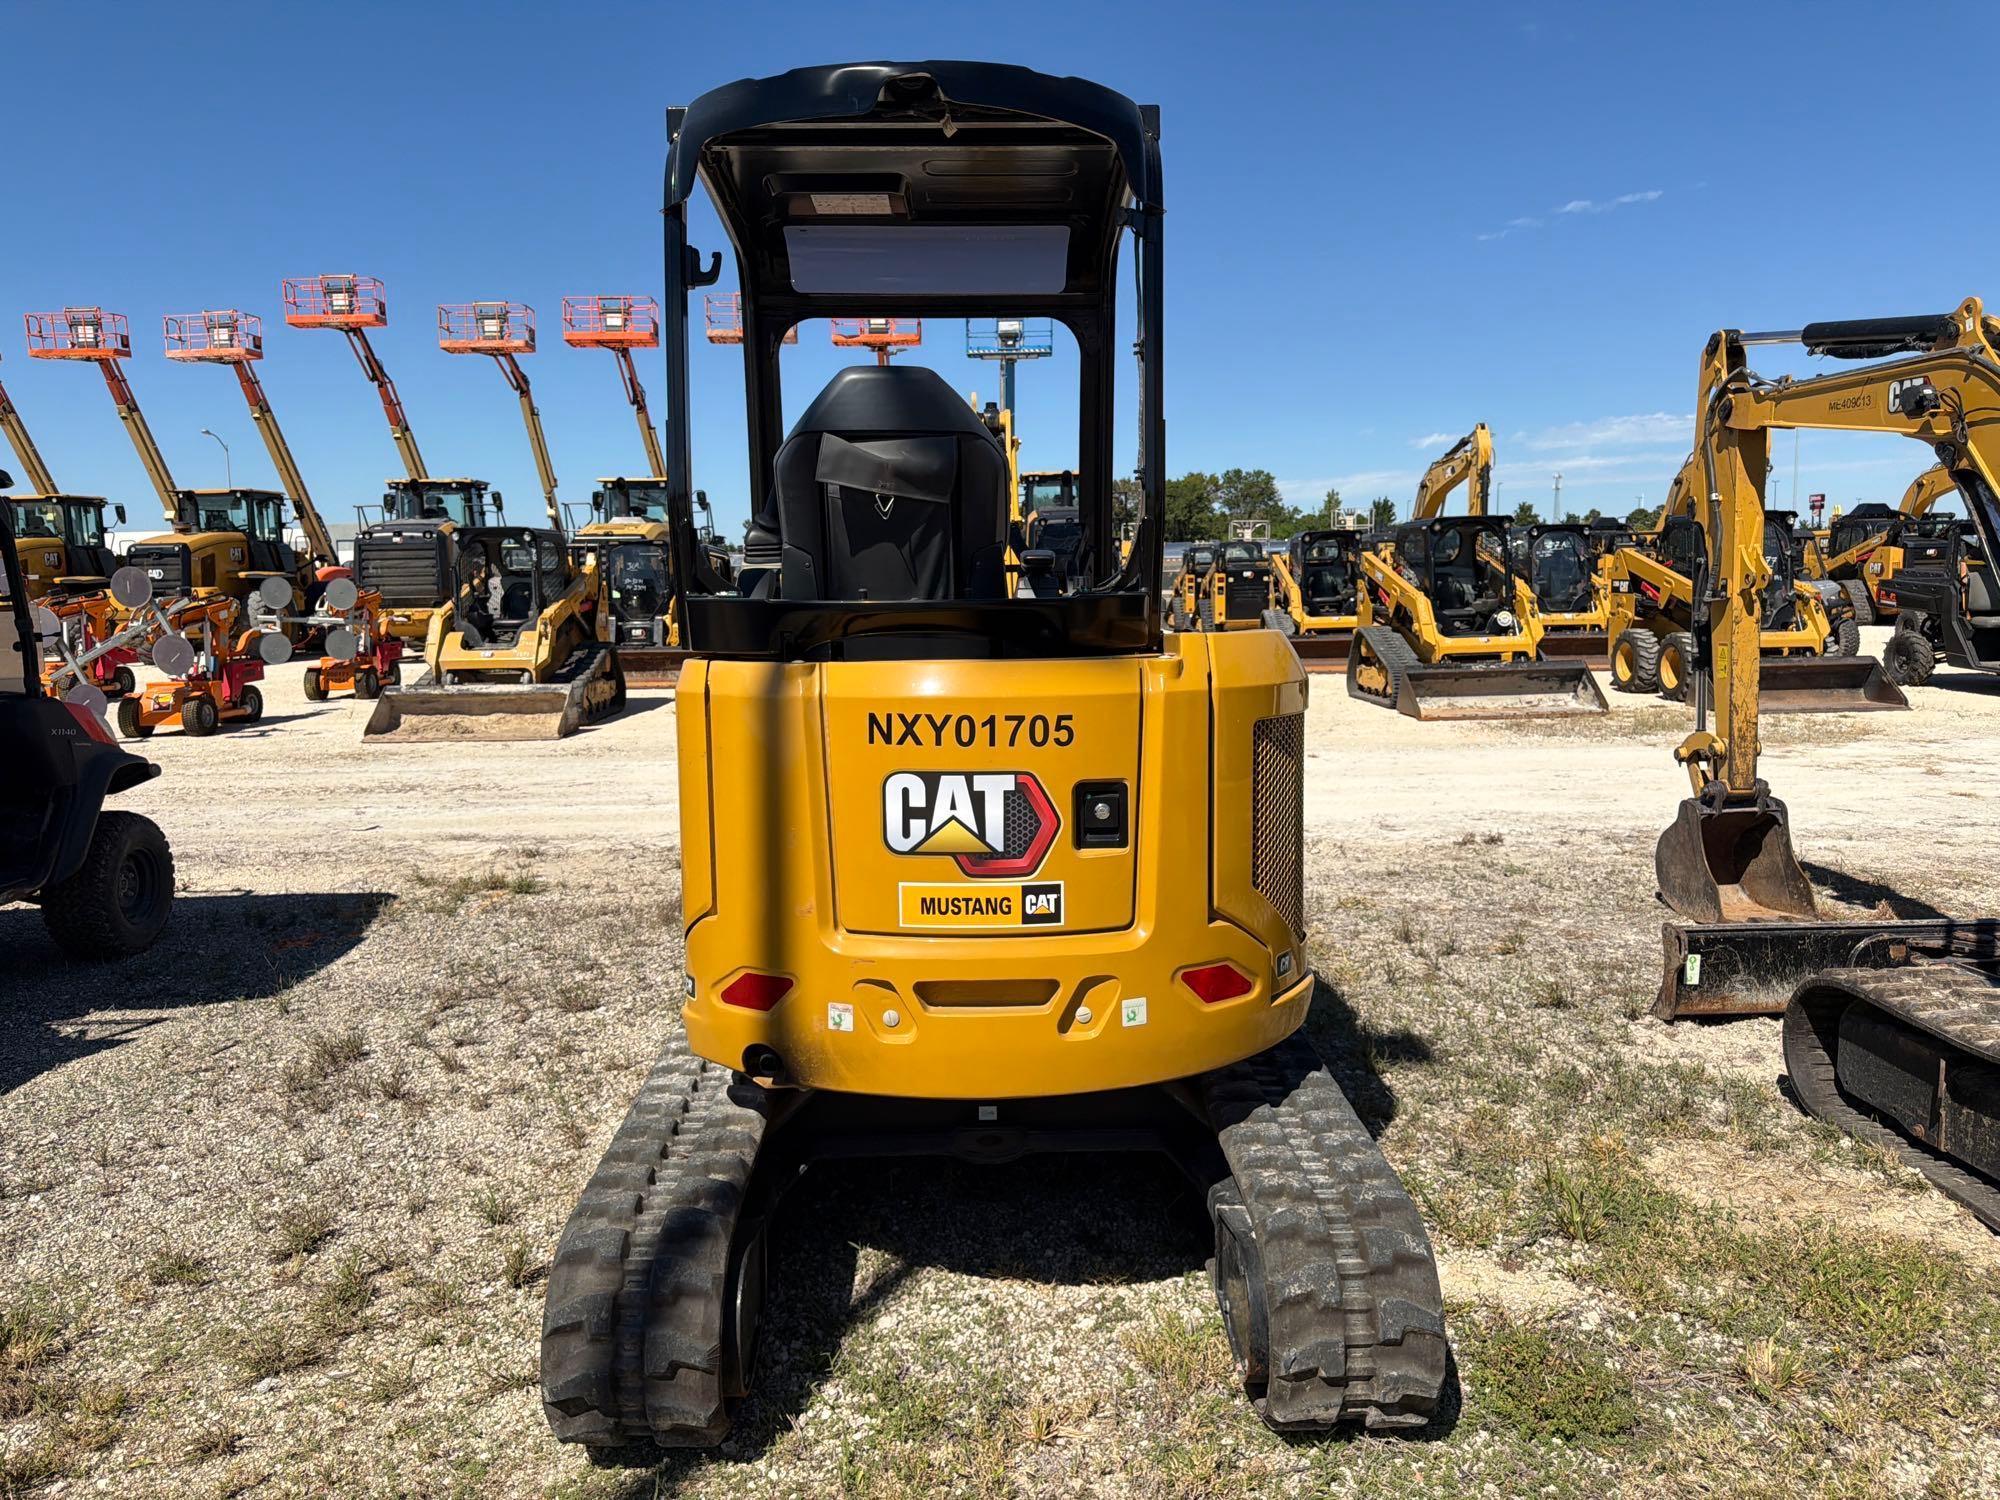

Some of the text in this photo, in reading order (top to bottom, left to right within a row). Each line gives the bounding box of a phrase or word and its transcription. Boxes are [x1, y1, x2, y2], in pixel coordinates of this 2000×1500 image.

[44, 552, 58, 566] CAT
[230, 547, 242, 561] CAT
[148, 569, 160, 579] CAT
[1869, 562, 1882, 574] CAT
[868, 712, 1075, 748] NXY01705
[885, 773, 1015, 852] CAT
[920, 893, 1058, 916] MUSTANG CAT
